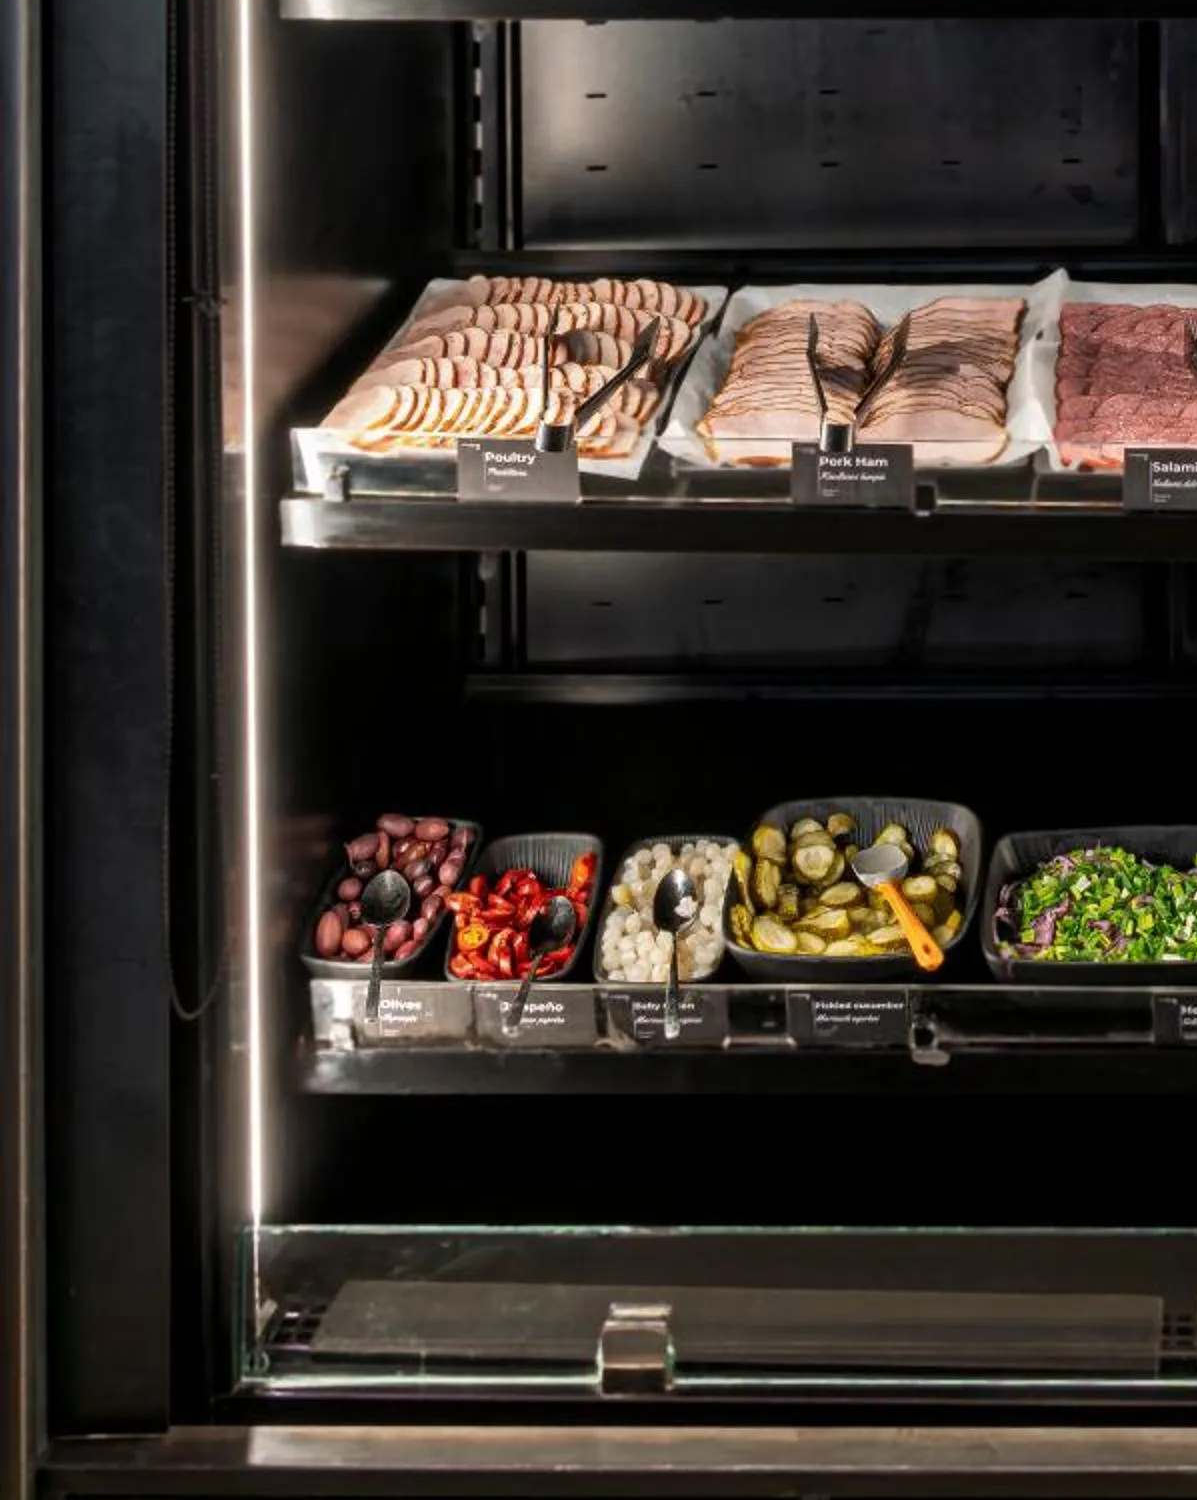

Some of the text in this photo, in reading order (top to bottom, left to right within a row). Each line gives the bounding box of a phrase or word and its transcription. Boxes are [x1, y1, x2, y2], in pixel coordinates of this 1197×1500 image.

[485, 452, 536, 465] Poultry
[819, 456, 889, 467] Pork Ham
